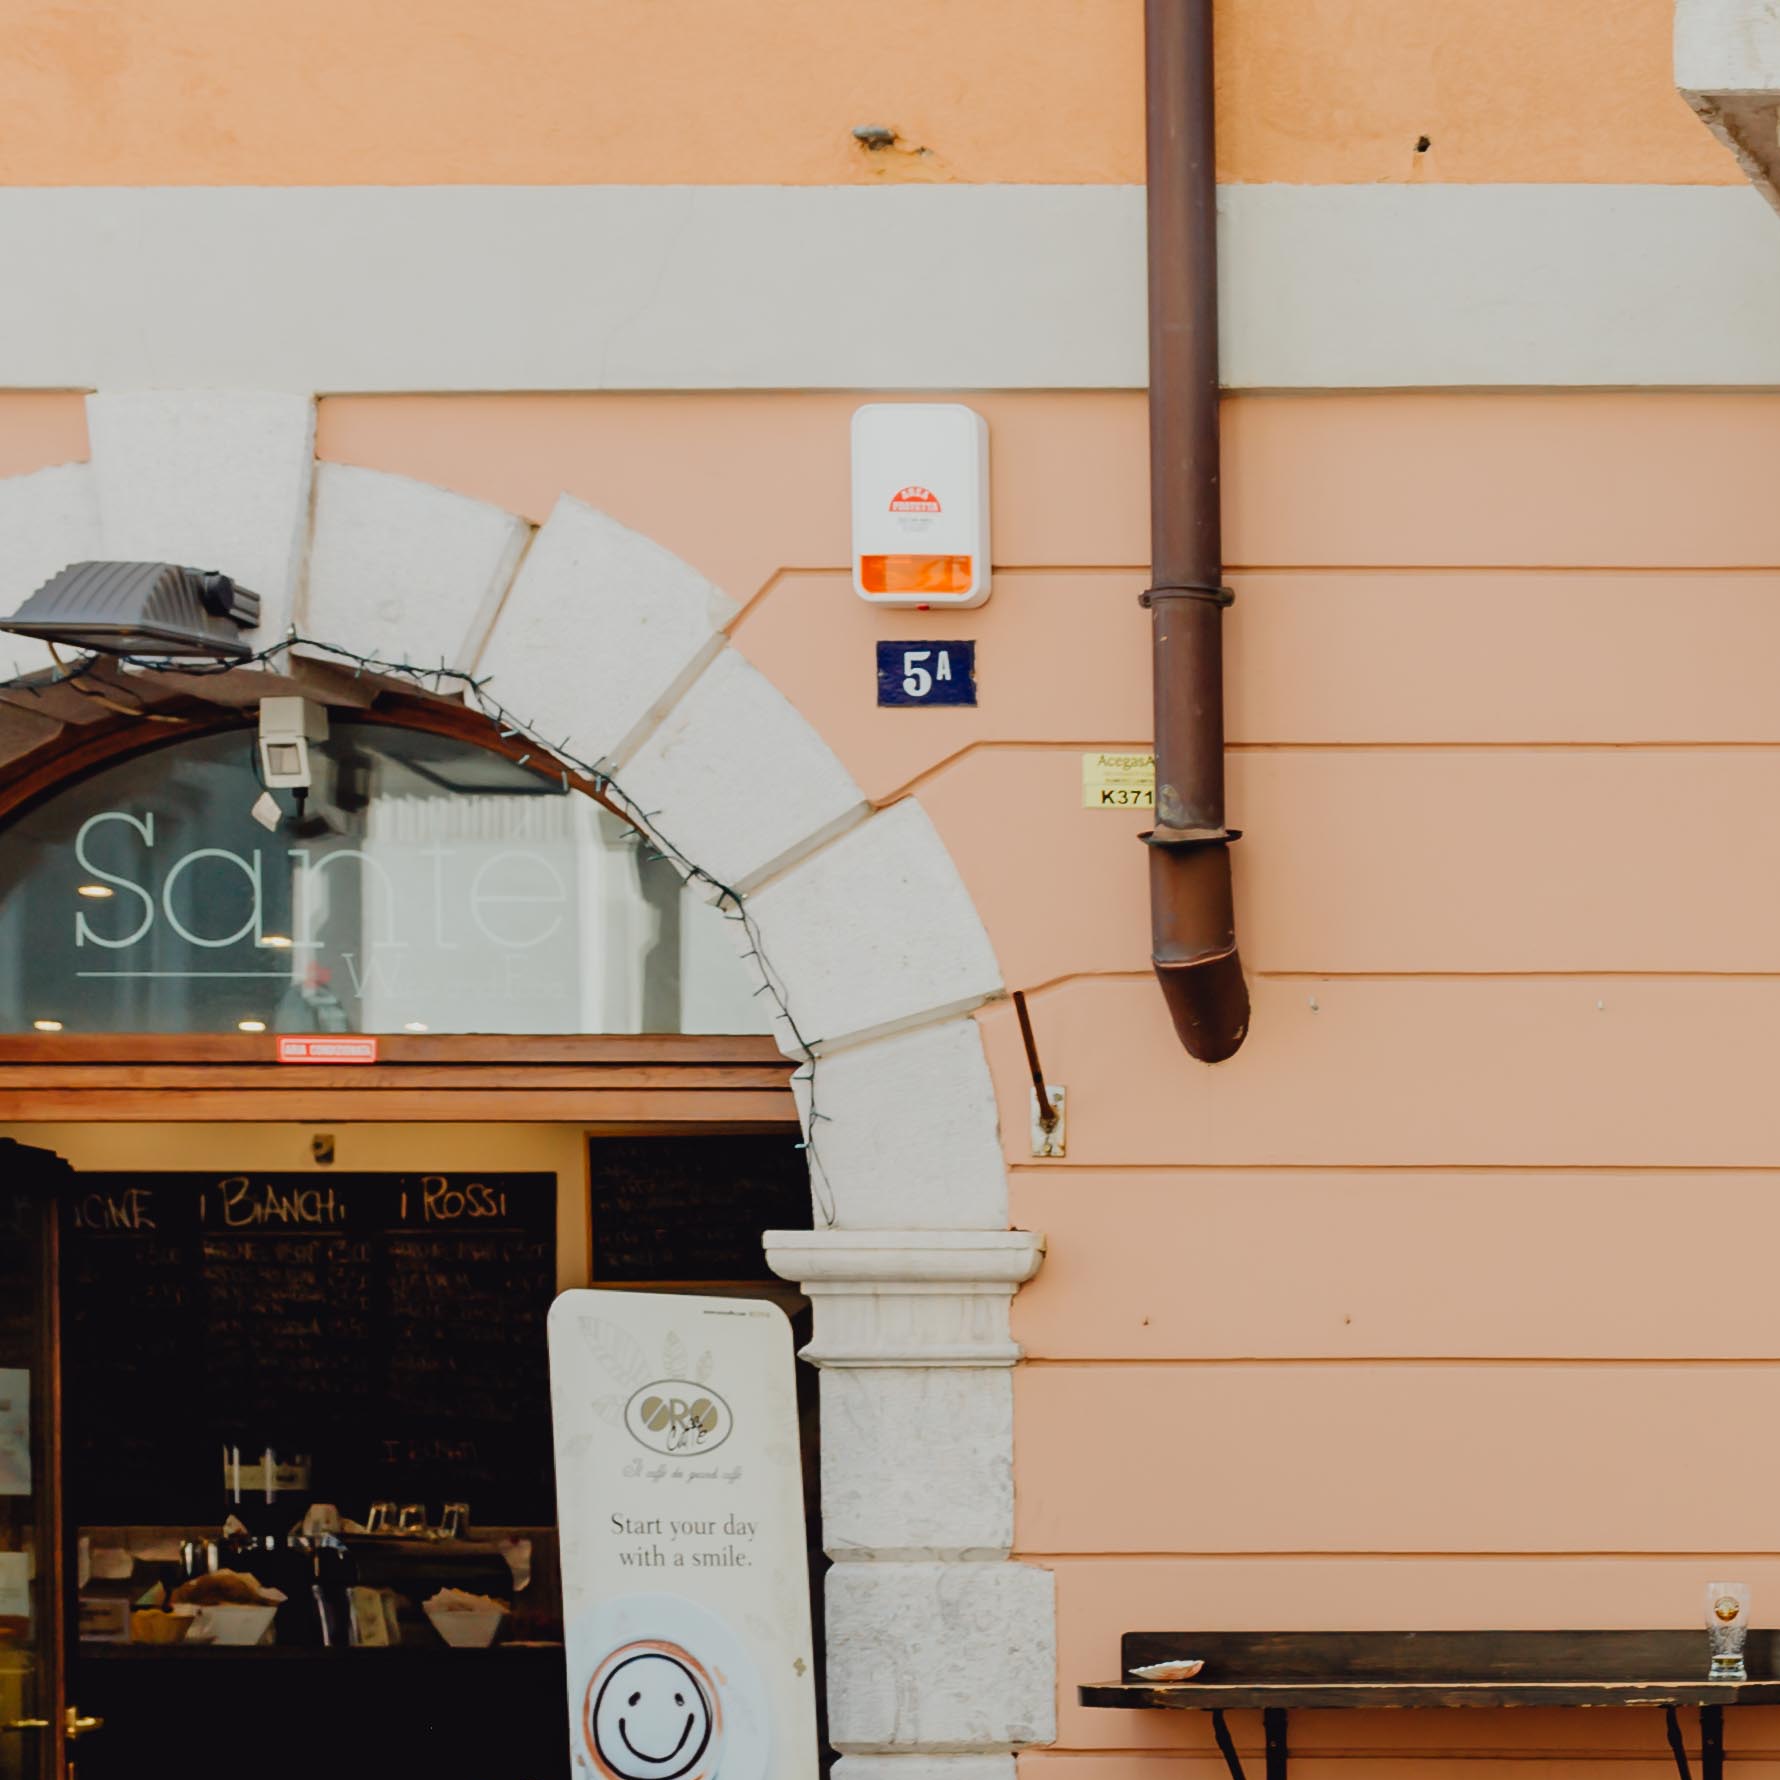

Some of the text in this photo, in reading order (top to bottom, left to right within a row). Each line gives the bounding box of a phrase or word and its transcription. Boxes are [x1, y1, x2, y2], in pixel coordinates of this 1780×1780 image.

[903, 650, 951, 697] 5A
[1101, 790, 1153, 804] K371
[611, 1512, 758, 1541] Start your day
[619, 1544, 752, 1567] with a smile.
